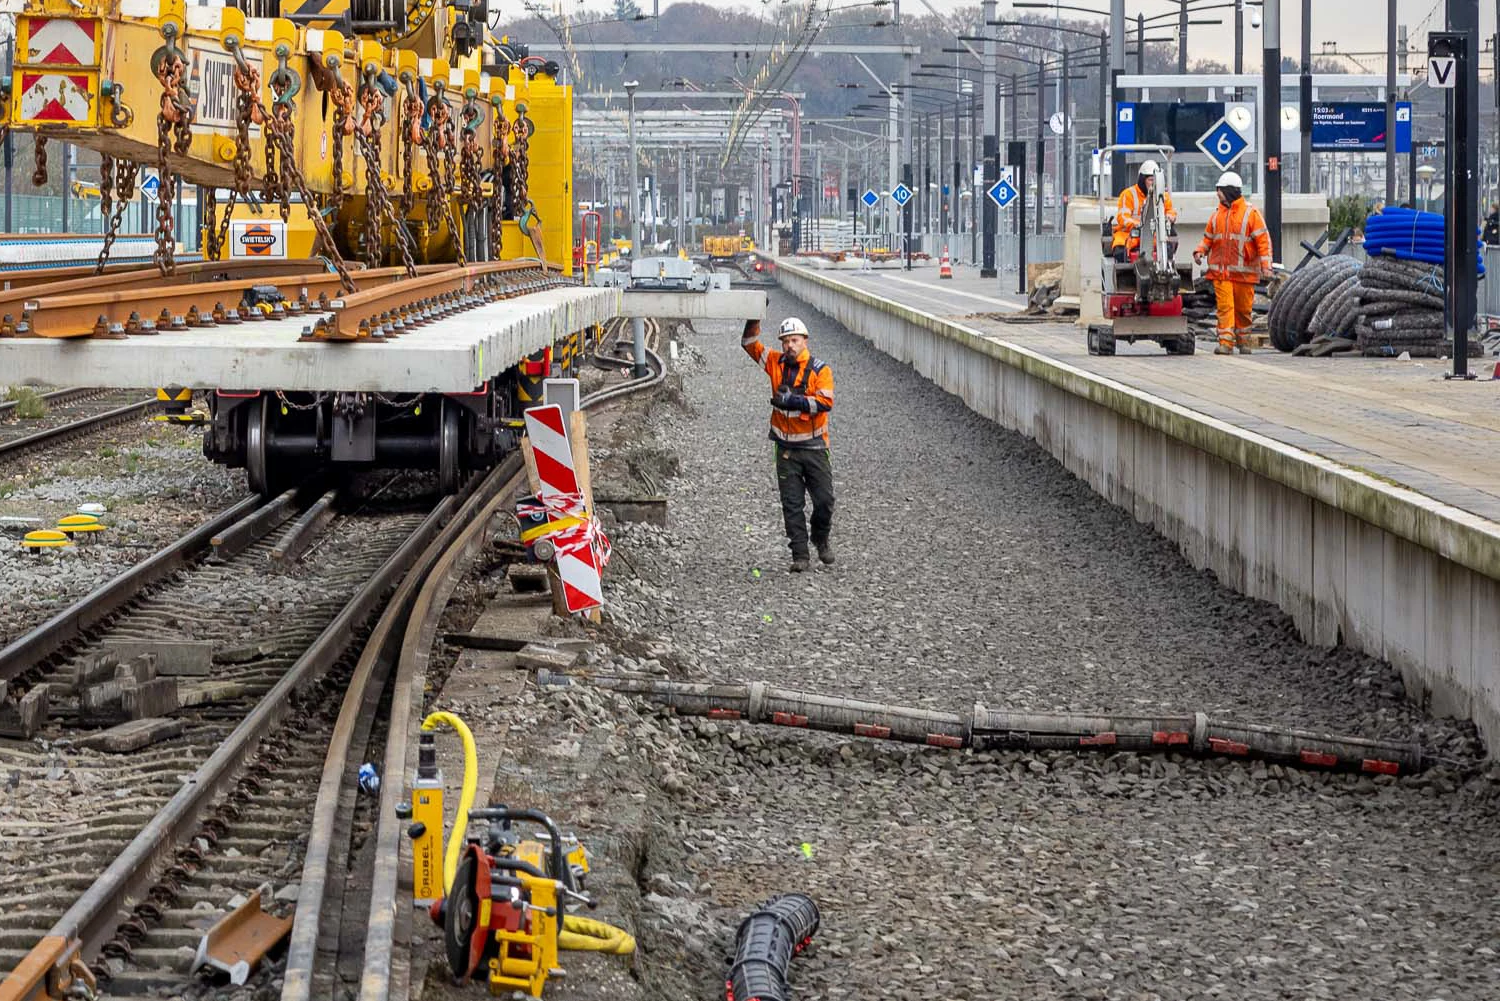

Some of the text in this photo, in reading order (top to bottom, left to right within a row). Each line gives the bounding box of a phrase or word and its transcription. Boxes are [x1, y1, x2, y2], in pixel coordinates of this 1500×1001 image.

[1431, 60, 1454, 85] V
[1313, 112, 1344, 120] Roermond
[1216, 132, 1232, 155] 6
[896, 189, 908, 201] 10
[998, 187, 1008, 200] 8
[241, 235, 275, 243] SWIETELSKY
[422, 843, 430, 886] ROBEL
